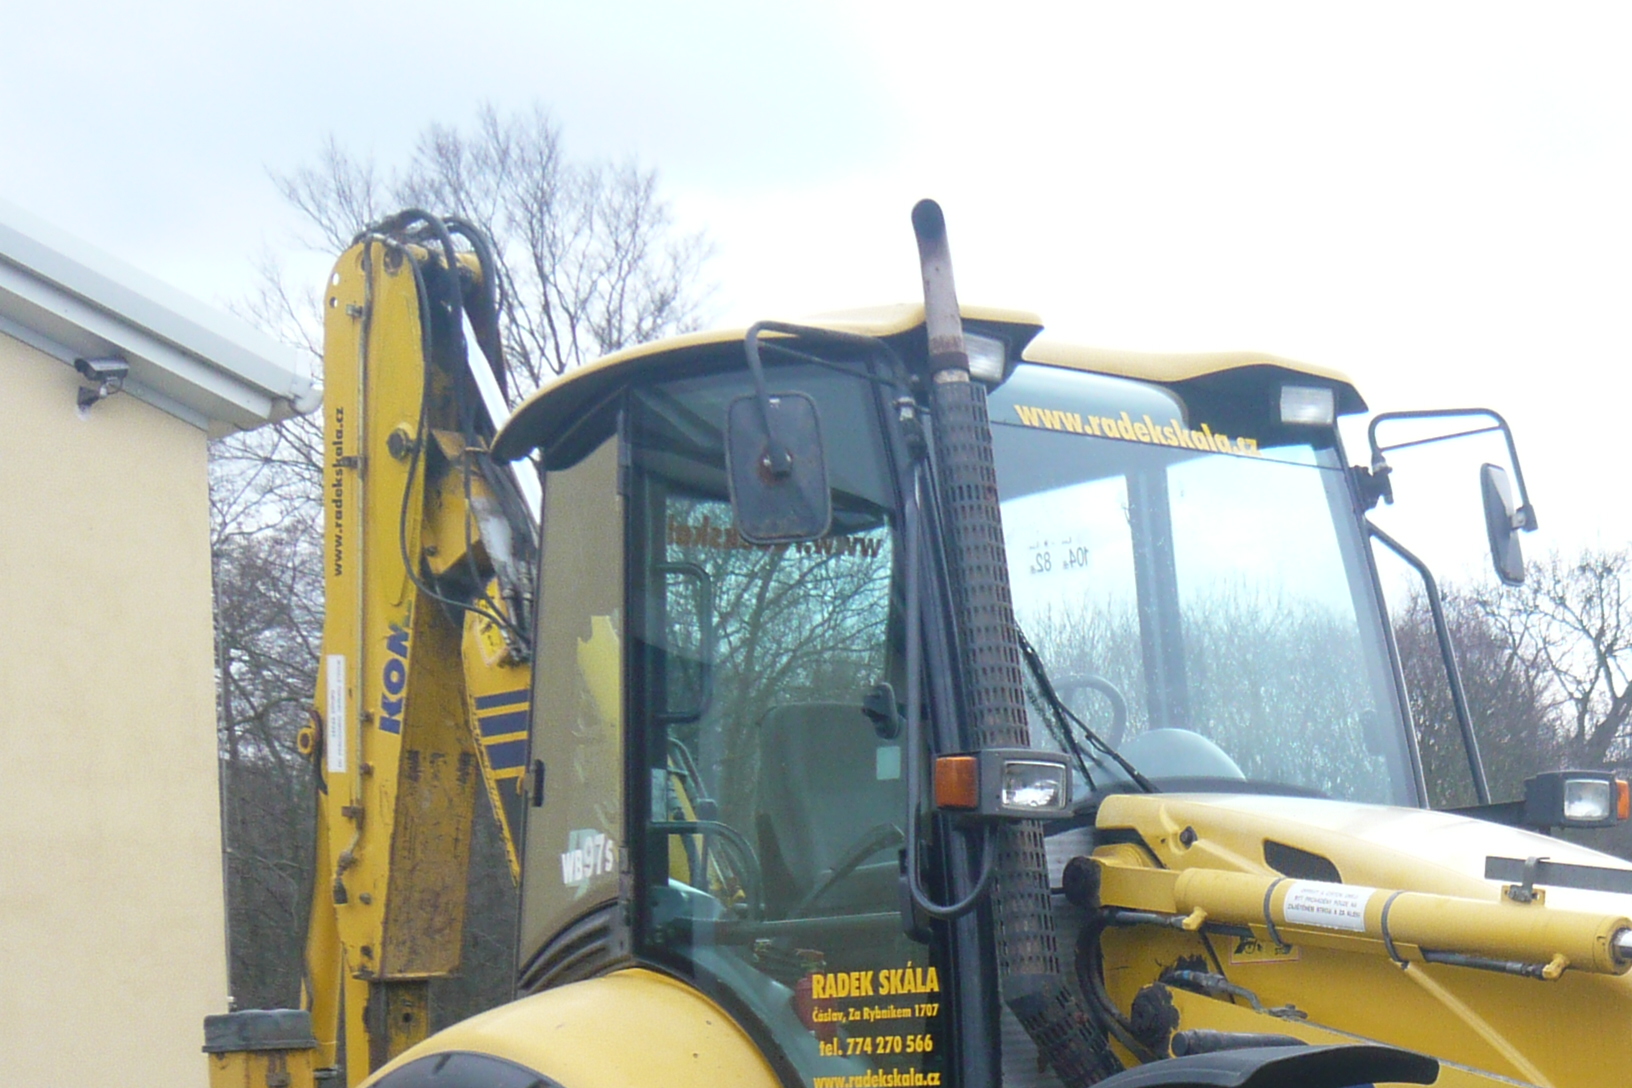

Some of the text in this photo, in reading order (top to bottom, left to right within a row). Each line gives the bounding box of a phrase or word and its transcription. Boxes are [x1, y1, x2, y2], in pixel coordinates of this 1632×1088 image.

[1013, 404, 1261, 456] www.radekskala.cz
[812, 961, 940, 999] RADEK SKÁLA
[848, 1008, 861, 1020] Za
[914, 1003, 940, 1017] 1707
[819, 1034, 933, 1056] tel. 774 270 566
